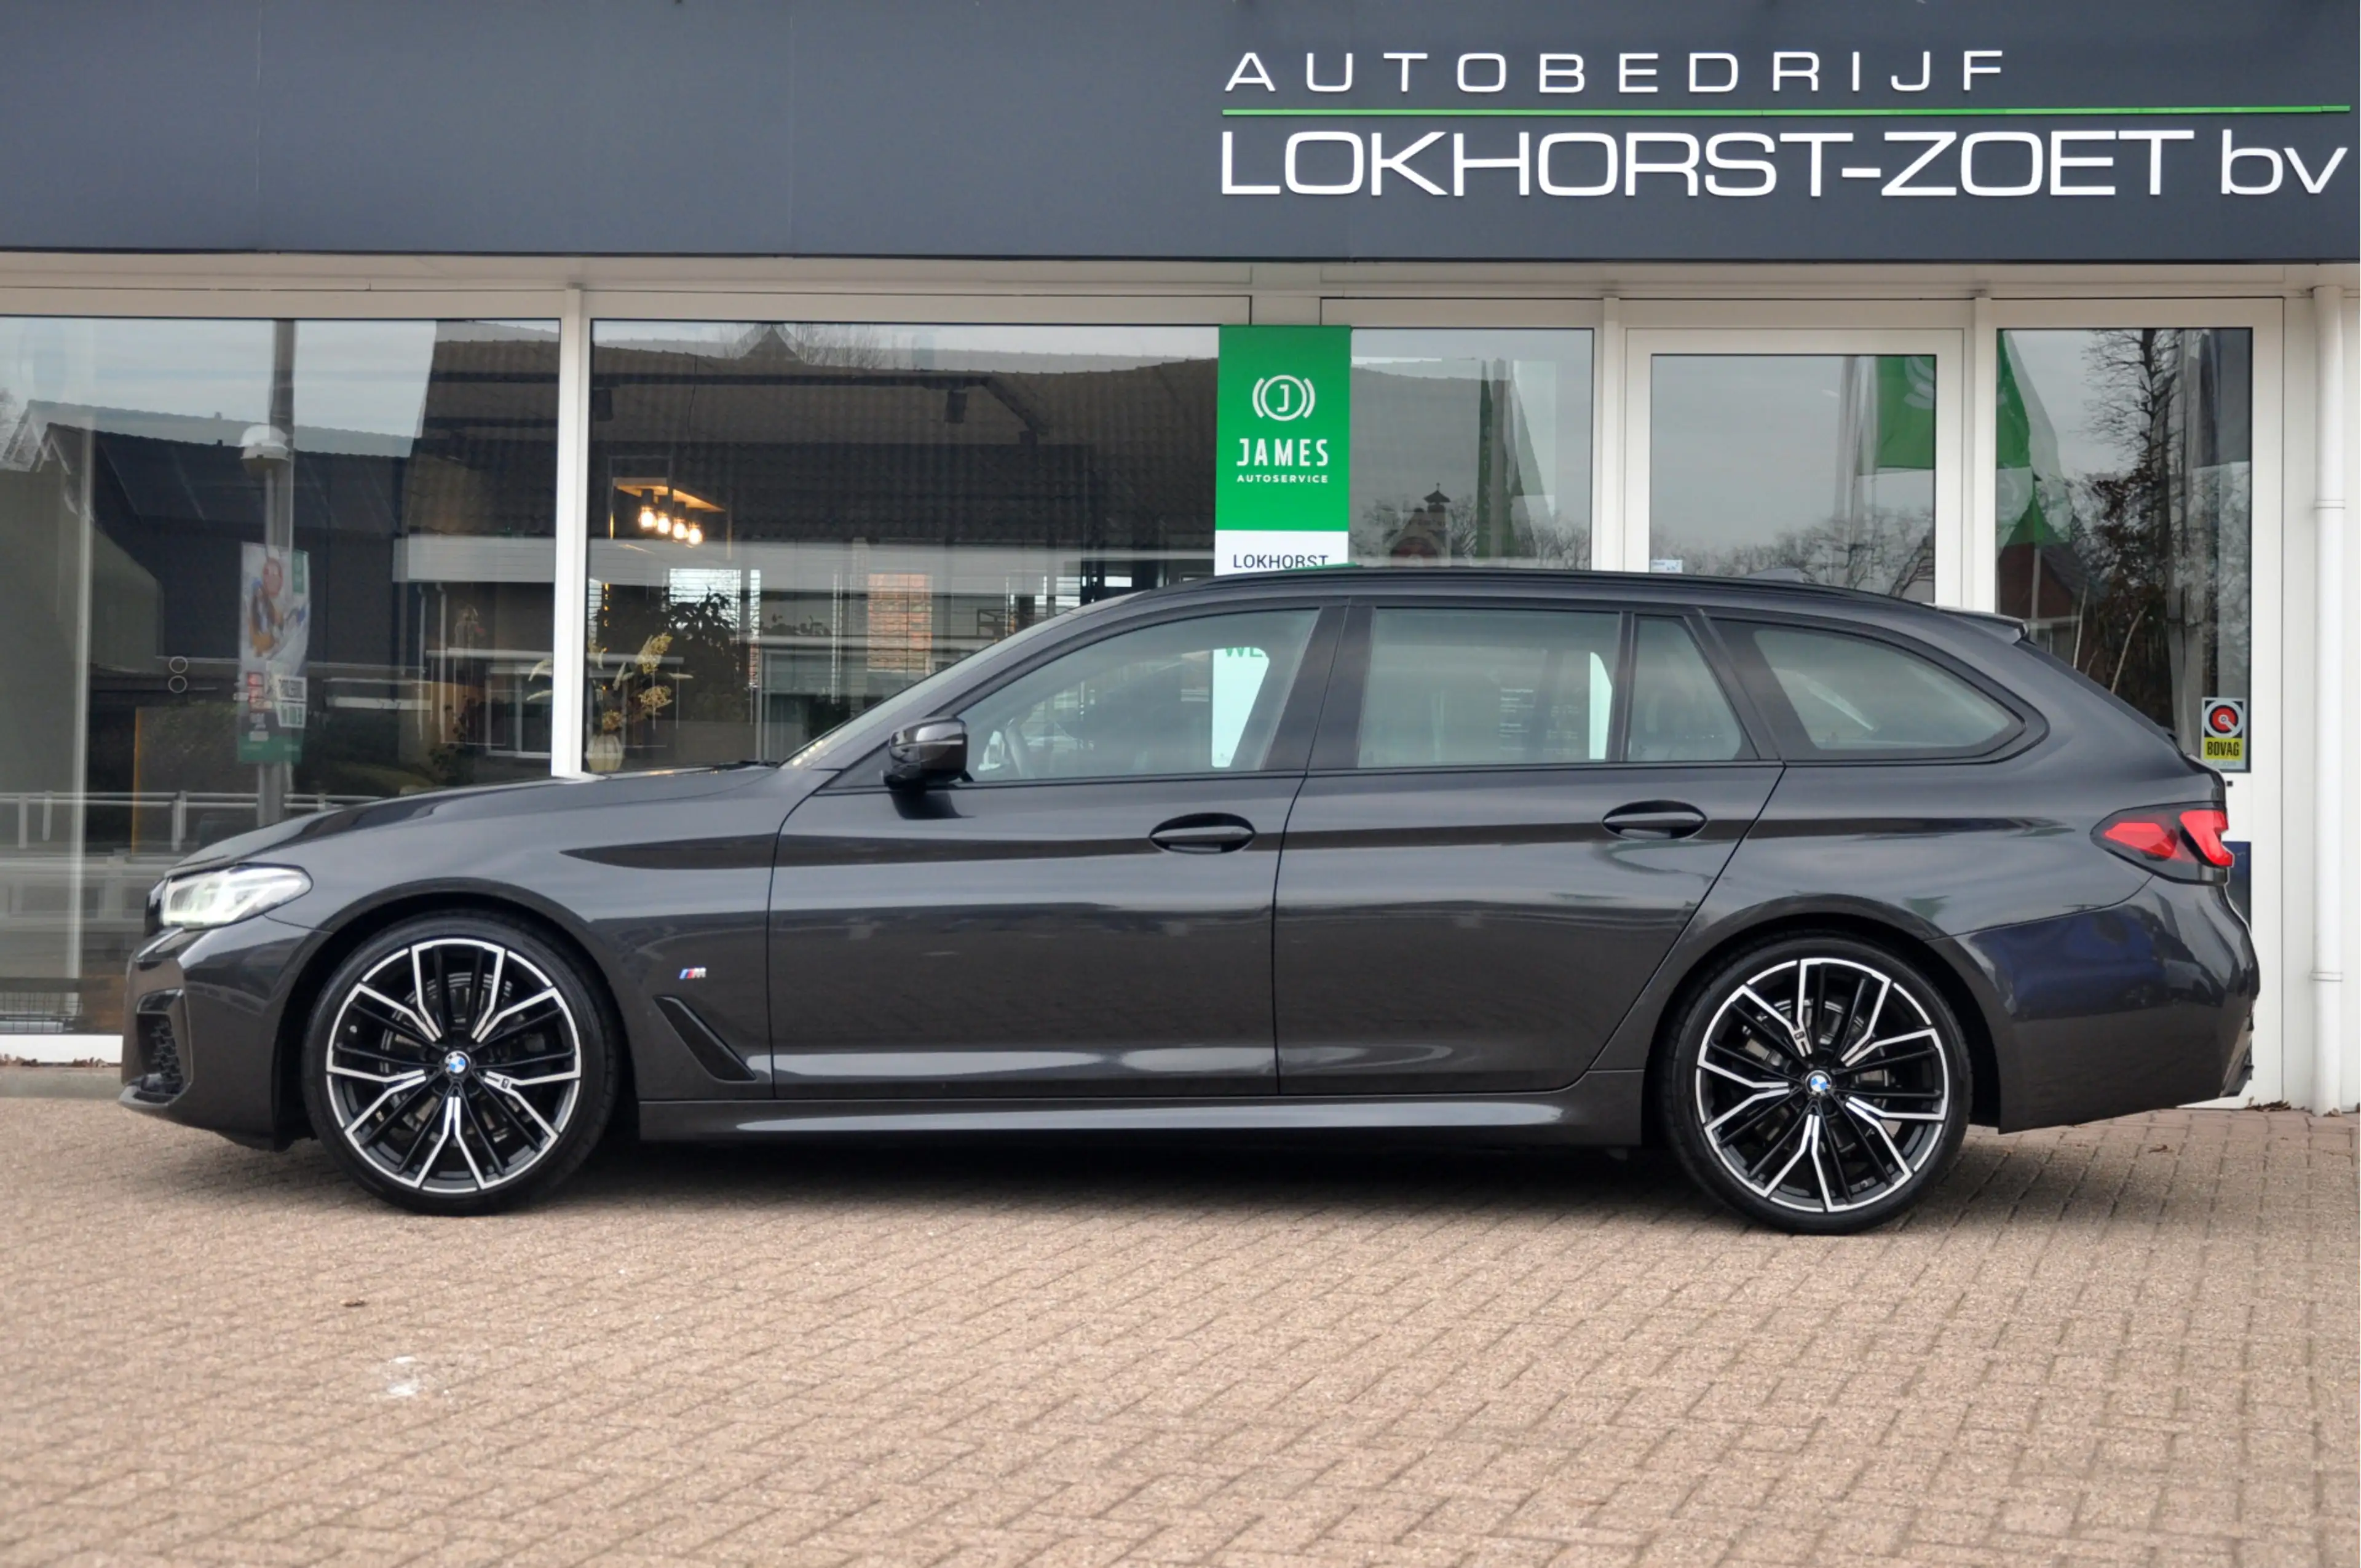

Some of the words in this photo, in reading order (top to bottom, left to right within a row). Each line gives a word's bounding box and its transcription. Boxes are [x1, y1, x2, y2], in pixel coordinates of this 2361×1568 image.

[1225, 50, 2003, 93] AUTOBEDRIJF
[1221, 130, 2194, 197] LOKHORST-ZOET
[2220, 129, 2349, 195] bv
[1236, 438, 1329, 467] JAMES
[1236, 474, 1329, 483] AUTOSERVICE
[2207, 741, 2240, 756] BOVAG
